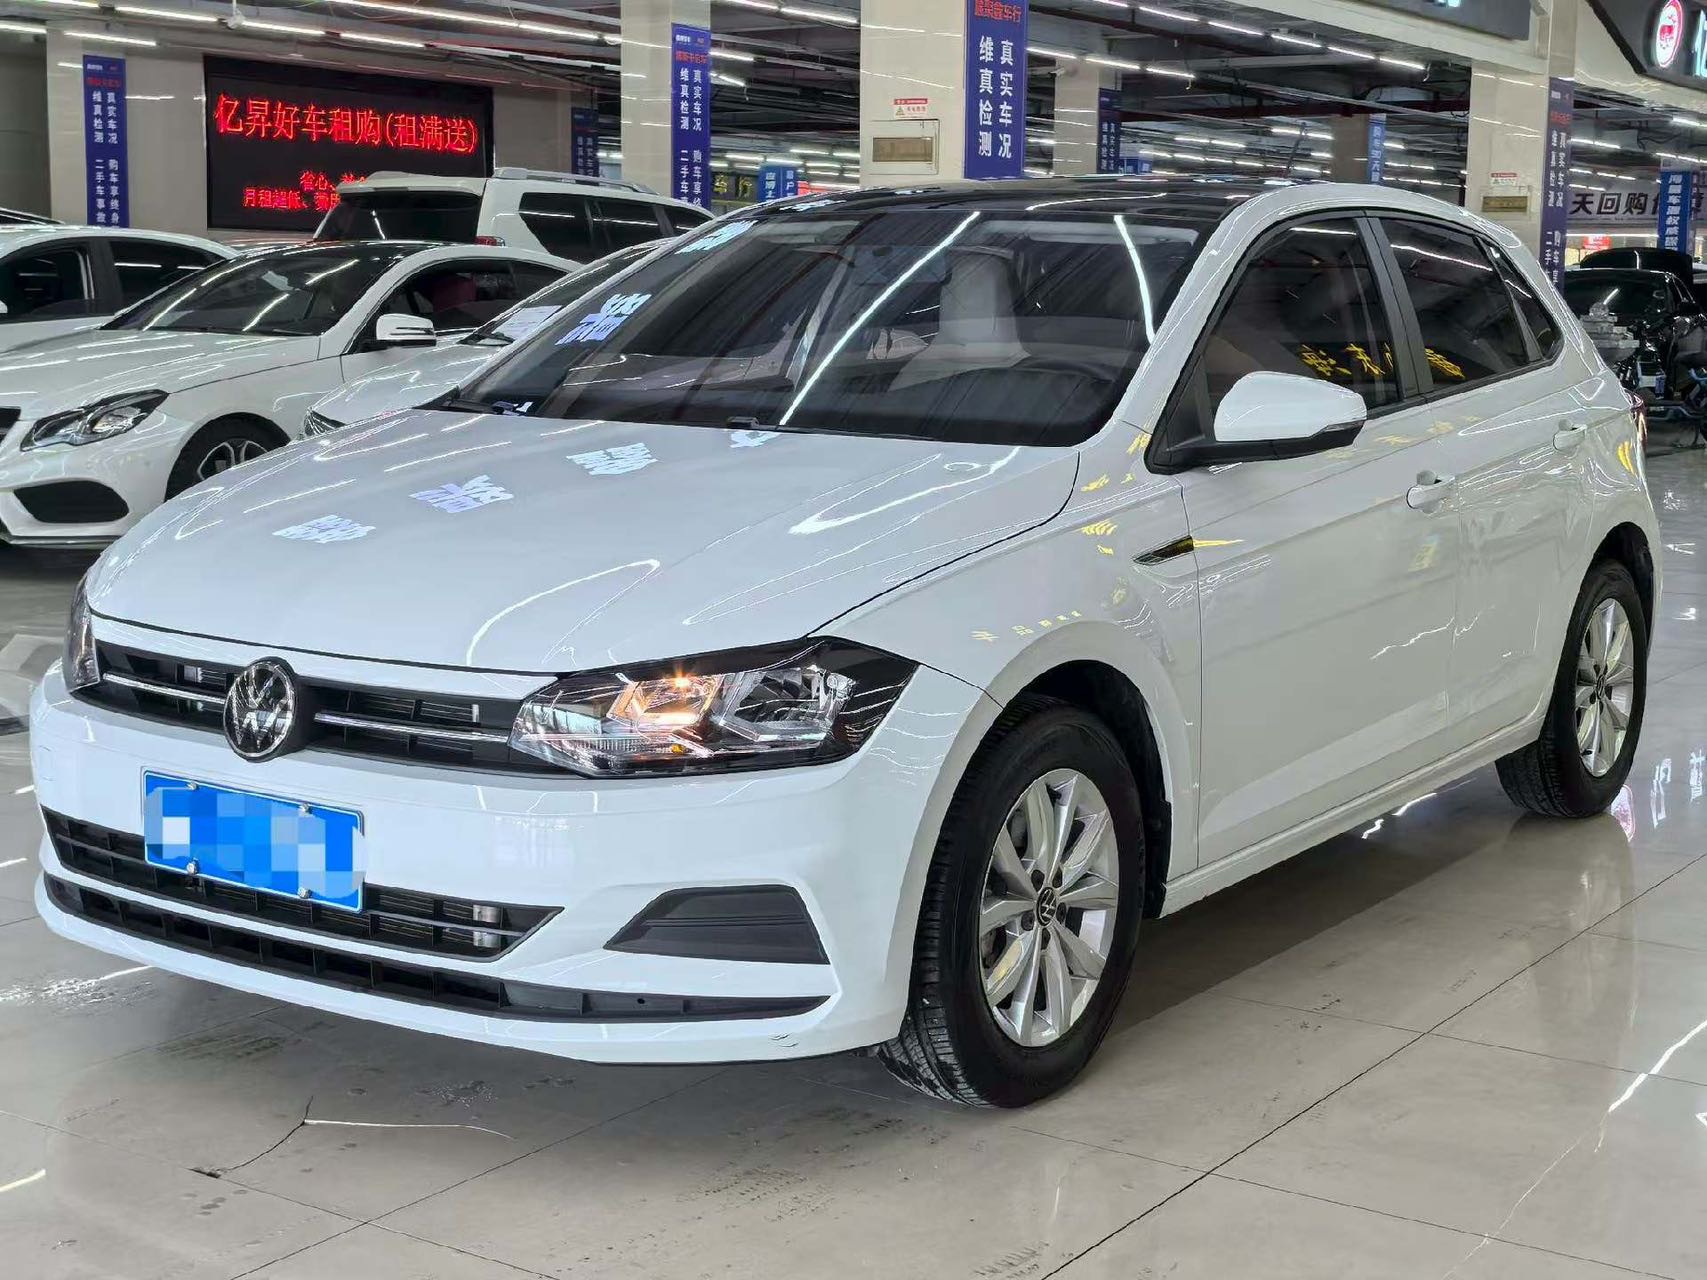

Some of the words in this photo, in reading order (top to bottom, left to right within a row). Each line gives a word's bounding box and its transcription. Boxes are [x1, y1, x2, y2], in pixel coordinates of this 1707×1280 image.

[214, 93, 479, 154] 亿昇好车租购(租满送)
[680, 67, 689, 130] 维真检测
[693, 69, 702, 132] 真实车况
[978, 35, 994, 158] 维真检测
[998, 40, 1014, 159] 真实车况
[108, 159, 120, 228] 购车享终身
[1569, 192, 1660, 216] 天回购
